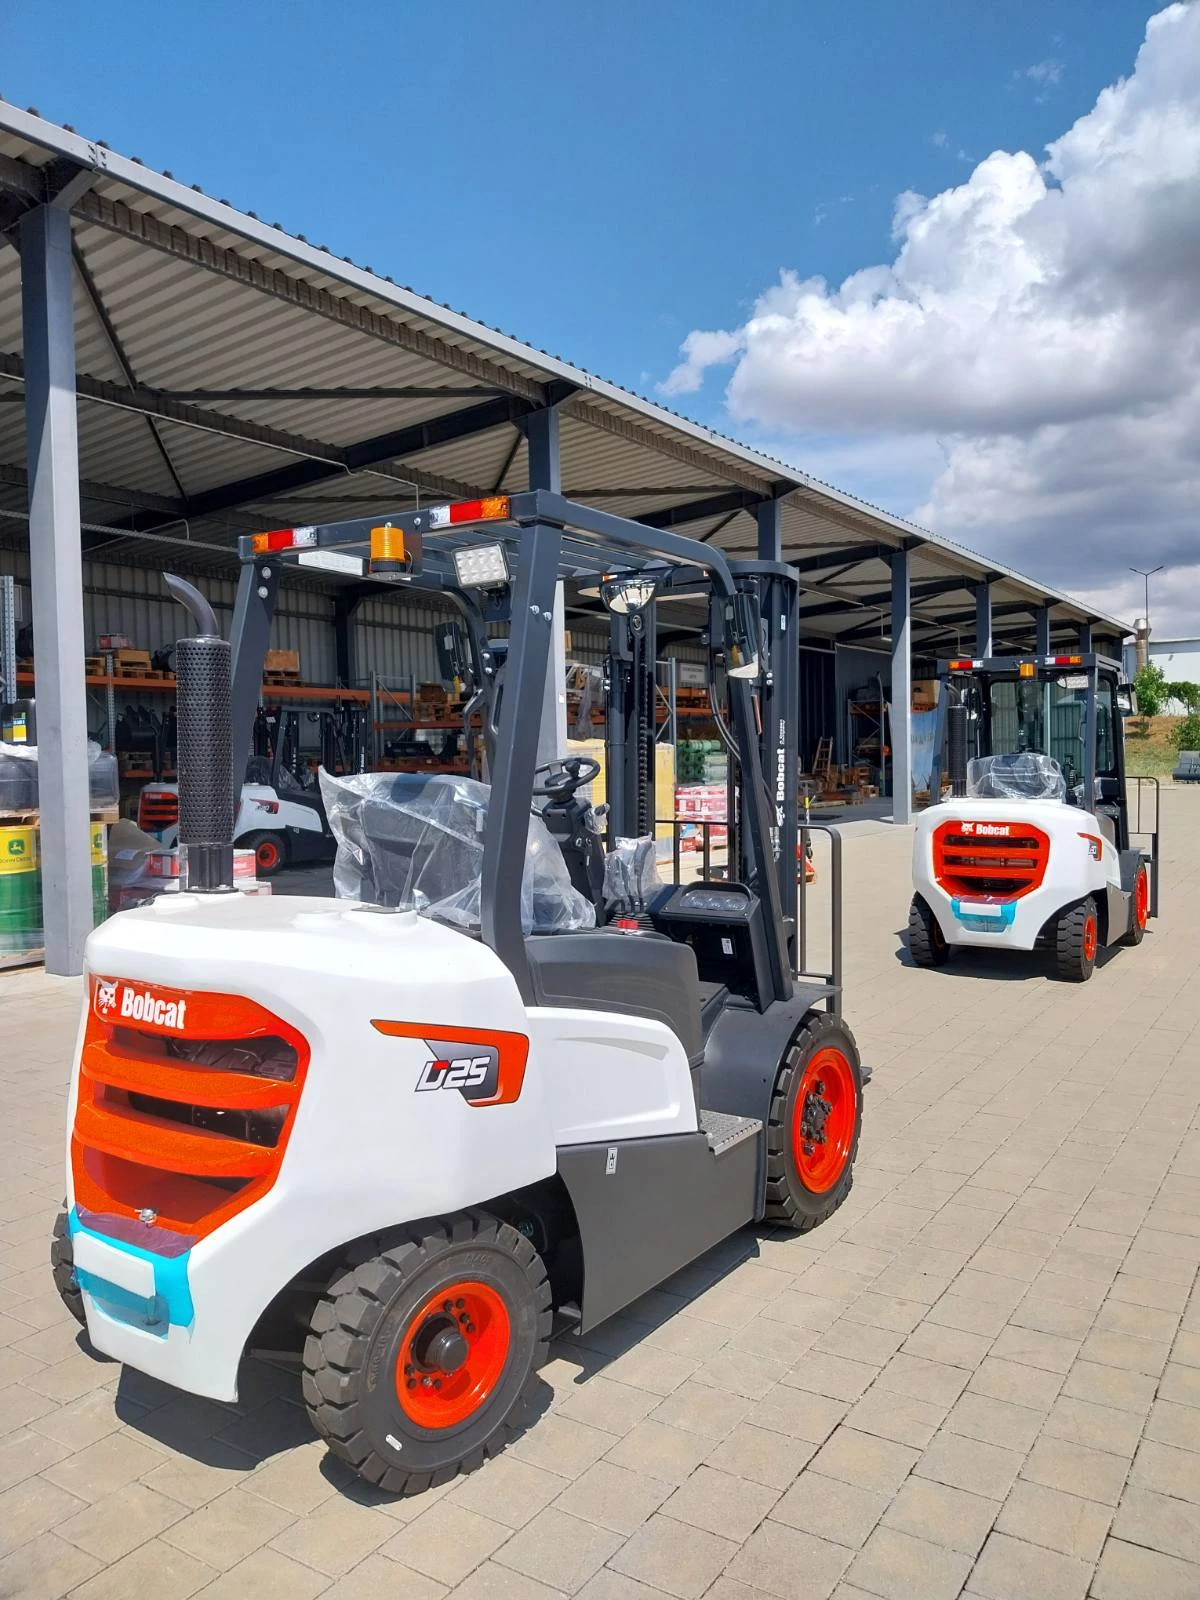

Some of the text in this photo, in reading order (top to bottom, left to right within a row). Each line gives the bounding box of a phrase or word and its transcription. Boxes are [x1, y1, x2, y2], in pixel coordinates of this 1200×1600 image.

[776, 748, 785, 801] Bobcat
[976, 824, 1009, 836] Bobcat
[121, 986, 186, 1030] Bobcat
[414, 1055, 491, 1092] D25
